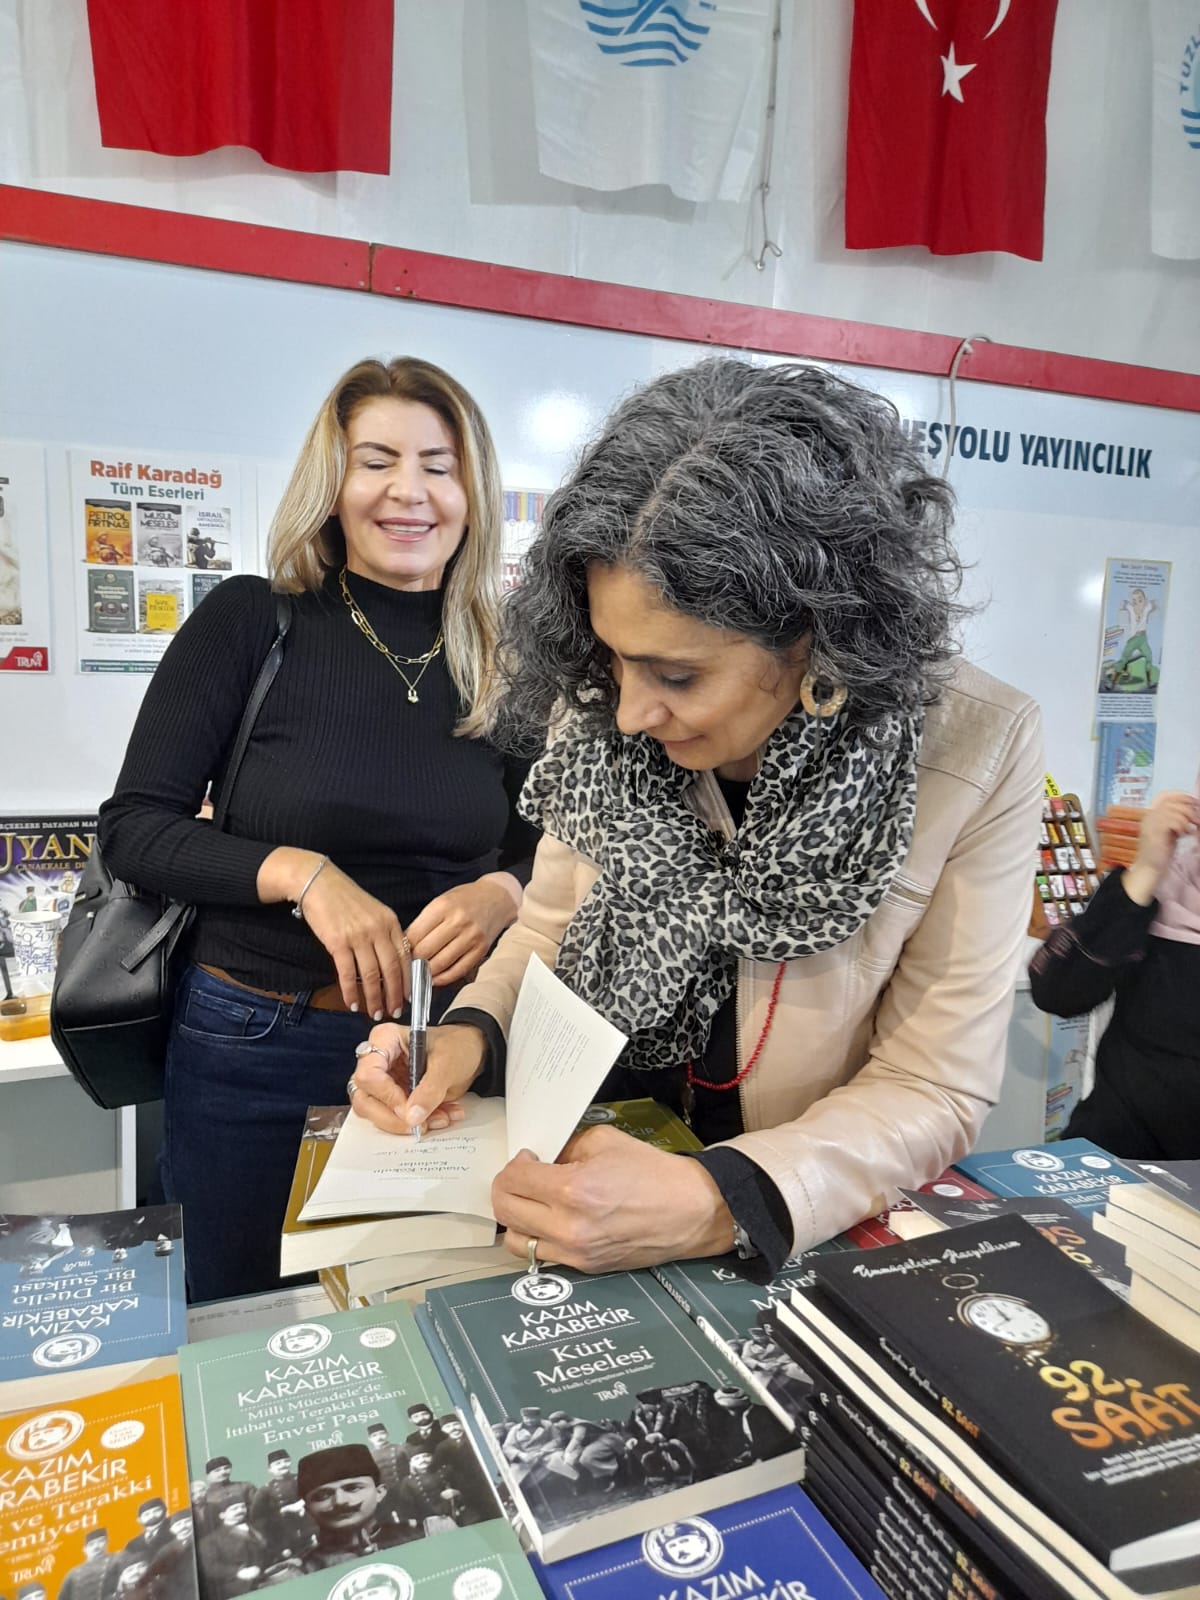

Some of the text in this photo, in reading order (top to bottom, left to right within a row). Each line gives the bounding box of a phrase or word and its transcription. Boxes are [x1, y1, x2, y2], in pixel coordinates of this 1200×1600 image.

[1020, 433, 1152, 478] YAYINCILIK
[90, 460, 222, 489] Raif Karadağ
[110, 482, 204, 500] Tüm Eserleri
[88, 510, 127, 521] PETROL
[1033, 1174, 1128, 1194] KARABEKİR
[1034, 1169, 1095, 1183] KAZIM
[12, 1275, 98, 1294] Suikast
[100, 1281, 133, 1293] Bir
[104, 1268, 136, 1281] Bir
[2, 1297, 139, 1329] KARABEKİR
[29, 1314, 111, 1338] KAZIM
[501, 1307, 635, 1348] KARABEKİR
[519, 1300, 600, 1327] KAZIM
[550, 1337, 617, 1363] Kürt
[264, 1353, 350, 1383] KAZIM
[532, 1345, 654, 1387] Meselesi
[1040, 1360, 1142, 1401] 92.
[237, 1360, 384, 1407] KARABEKİR
[225, 1417, 272, 1439] İttihat
[277, 1414, 295, 1424] ve
[300, 1401, 355, 1419] Terakki
[248, 1406, 284, 1421] Milli
[262, 1409, 380, 1444] Enver Paşa
[1051, 1383, 1200, 1449] SAAT
[11, 1475, 153, 1532] ve Terakki
